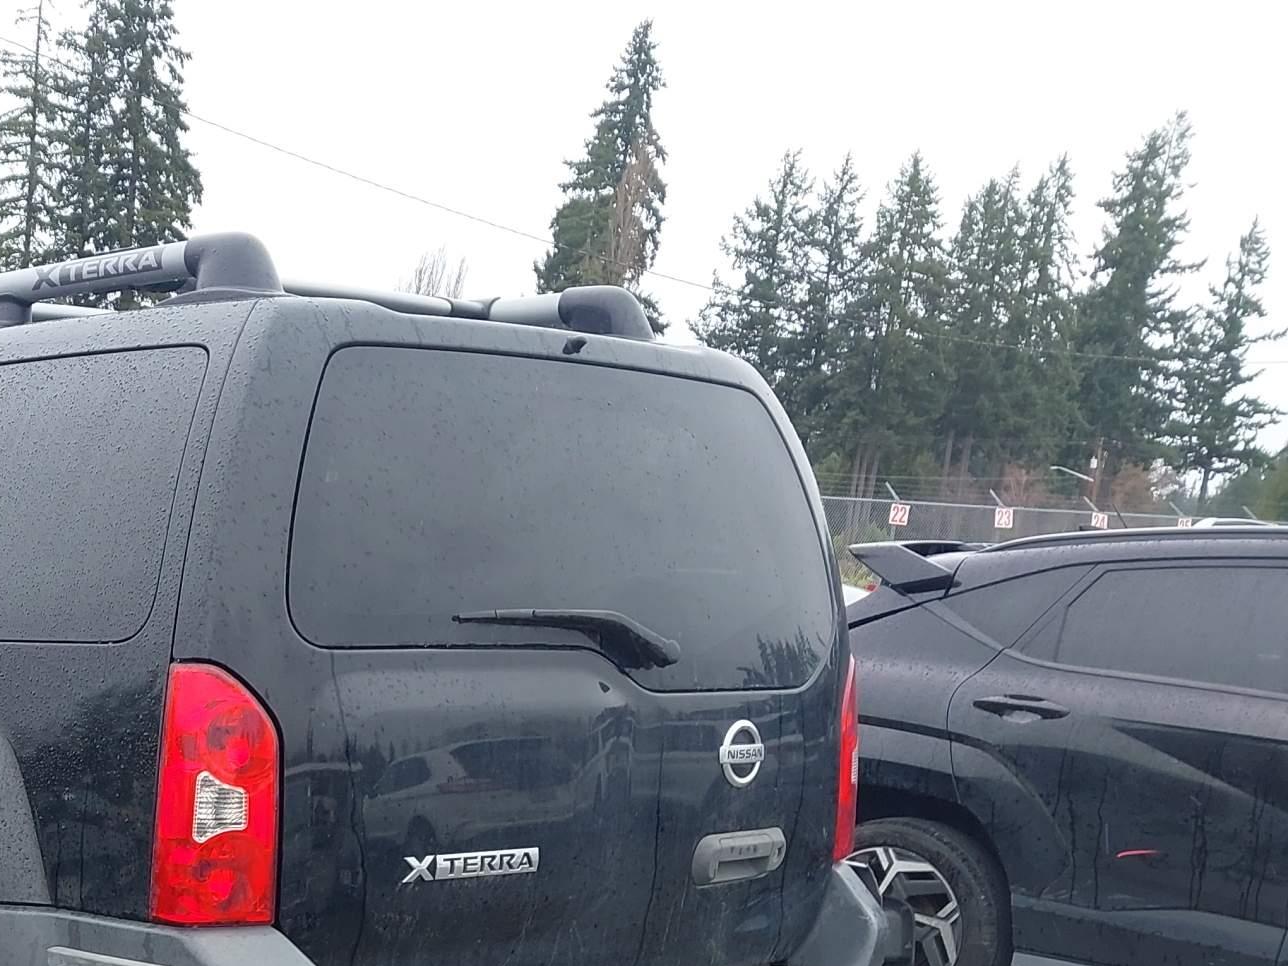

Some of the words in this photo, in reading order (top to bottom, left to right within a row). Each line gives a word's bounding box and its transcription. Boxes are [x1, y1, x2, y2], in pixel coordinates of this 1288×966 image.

[32, 250, 159, 291] XTERRA
[891, 505, 907, 523] 22
[997, 509, 1011, 526] 23
[727, 748, 762, 760] NISSAN
[402, 849, 536, 884] XTERRA
